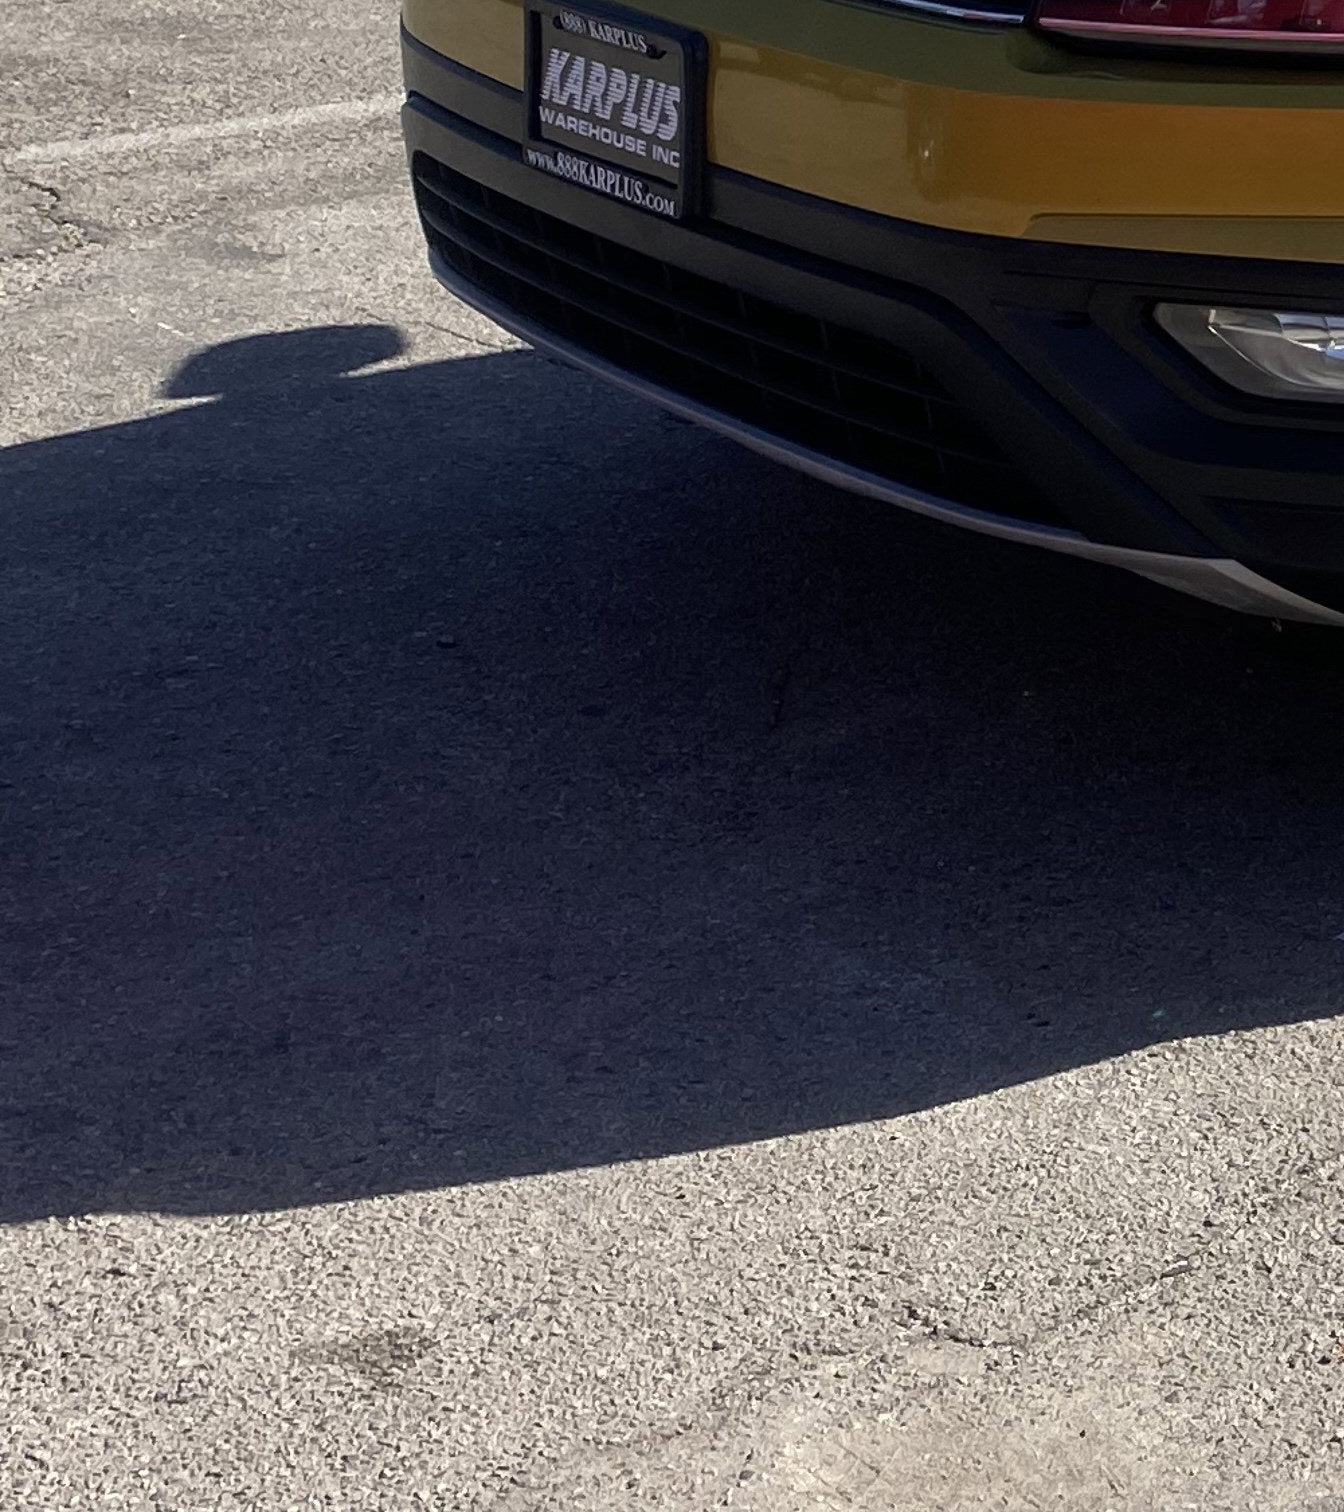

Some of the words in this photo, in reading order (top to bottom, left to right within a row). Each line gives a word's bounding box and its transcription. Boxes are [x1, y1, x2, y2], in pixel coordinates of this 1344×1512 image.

[589, 19, 648, 54] KARPLUS
[541, 47, 682, 141] KARPLUS
[538, 105, 647, 157] WAREHOUSE
[652, 144, 681, 169] INC
